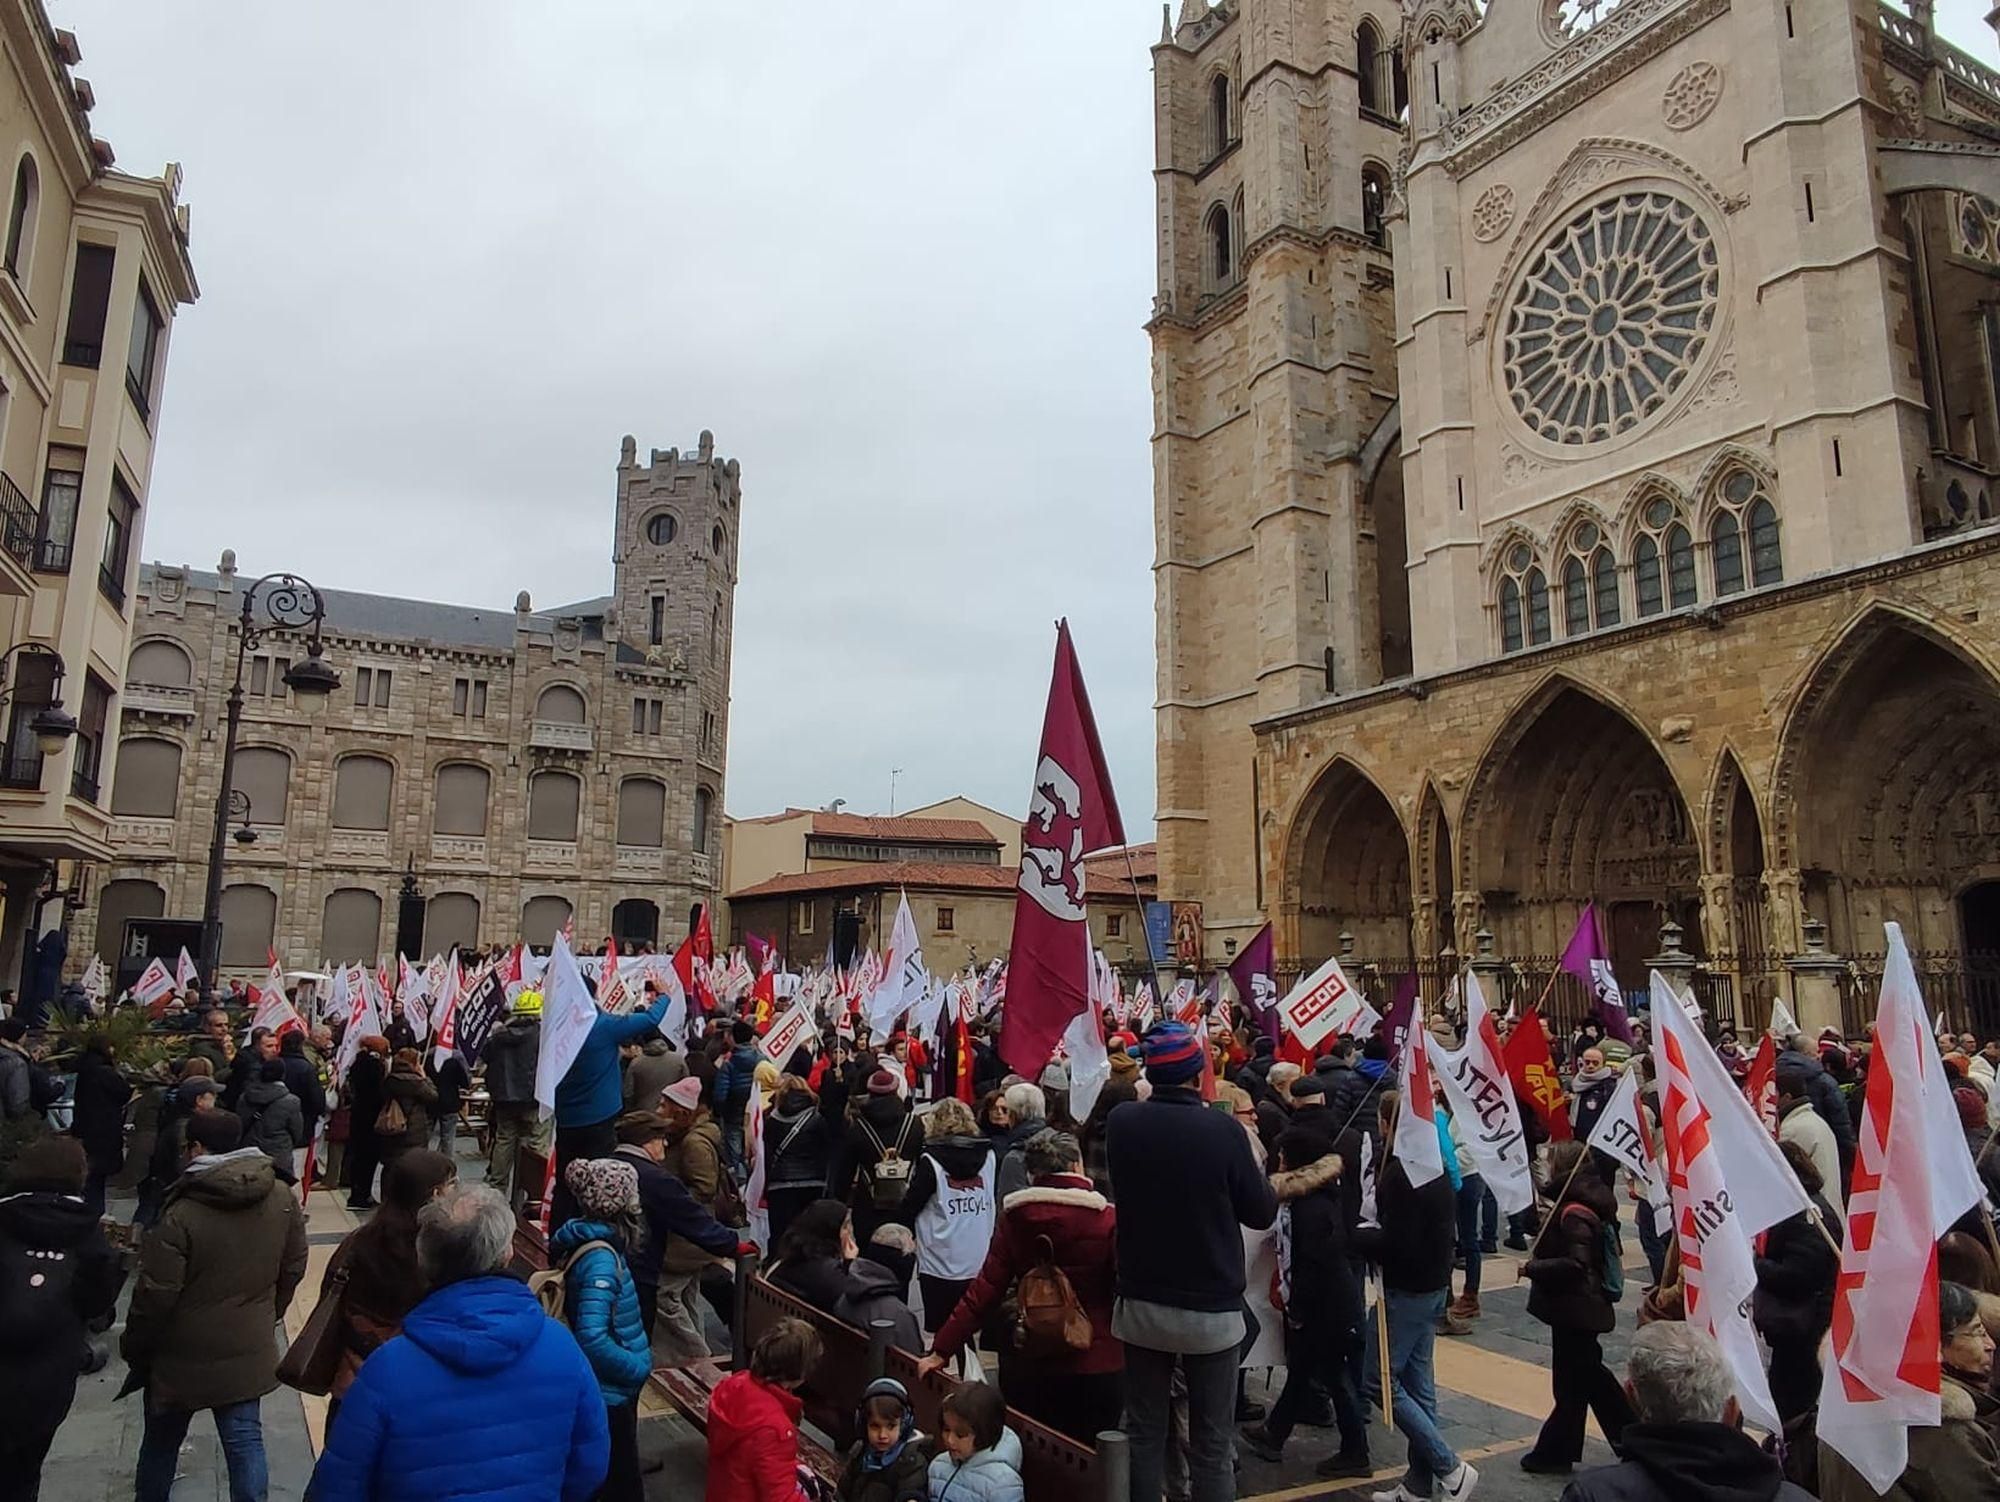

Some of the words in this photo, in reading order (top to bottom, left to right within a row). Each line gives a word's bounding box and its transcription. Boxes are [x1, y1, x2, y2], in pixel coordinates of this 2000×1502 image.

[461, 974, 495, 1041] CCOO
[1292, 980, 1342, 1023] CCOO
[770, 1015, 803, 1054] CCOO
